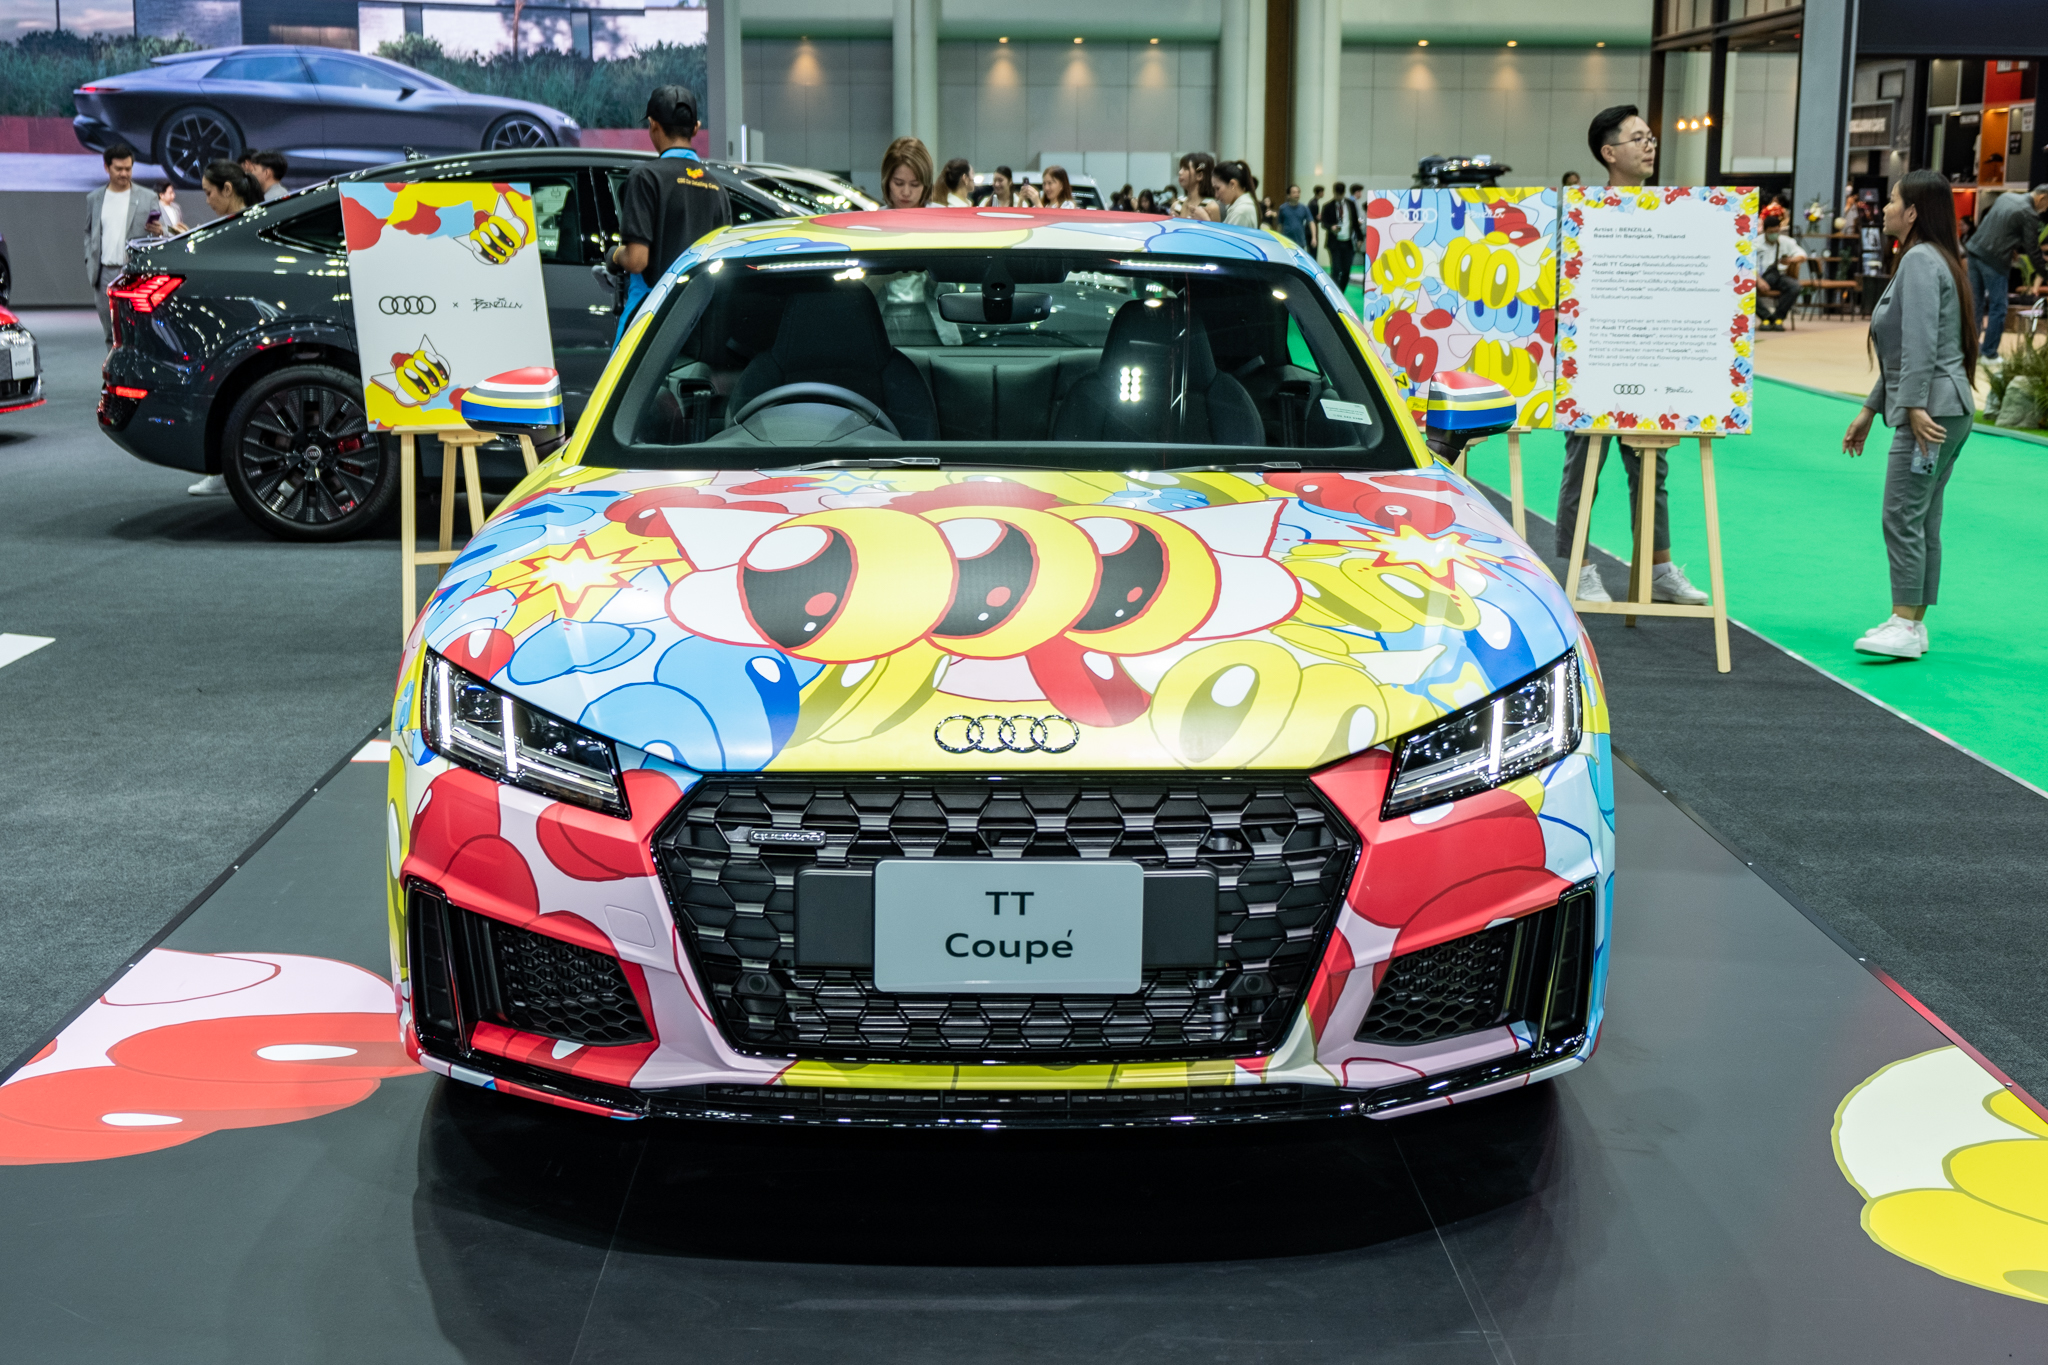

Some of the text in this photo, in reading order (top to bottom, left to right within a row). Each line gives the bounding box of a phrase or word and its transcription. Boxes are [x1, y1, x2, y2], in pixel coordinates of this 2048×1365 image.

[752, 831, 821, 841] quattro
[985, 891, 1034, 916] TT
[945, 929, 1074, 964] Coupé
